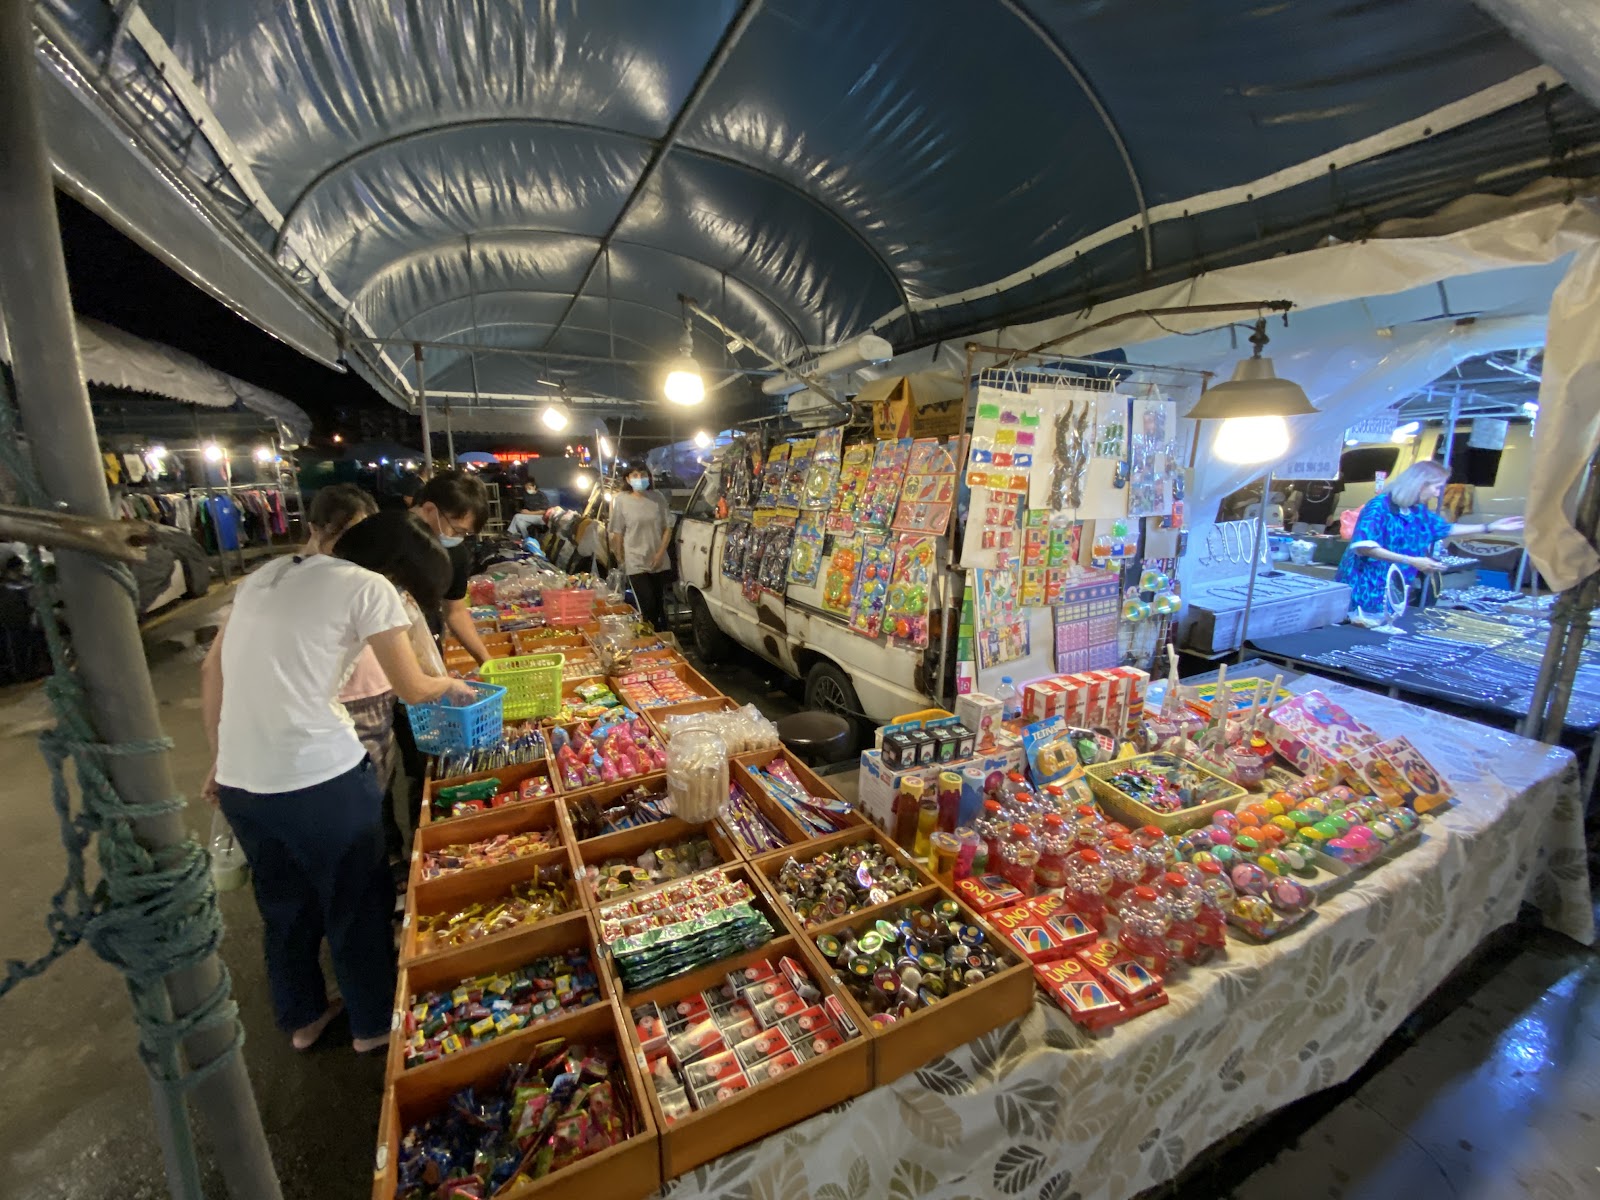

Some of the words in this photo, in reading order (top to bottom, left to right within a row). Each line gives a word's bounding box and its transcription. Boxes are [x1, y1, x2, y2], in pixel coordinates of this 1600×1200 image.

[961, 880, 995, 903] UNO
[999, 907, 1030, 928] UNO
[1033, 896, 1064, 917] UNO
[1089, 943, 1118, 967] UNO
[1046, 961, 1081, 983] UNO
